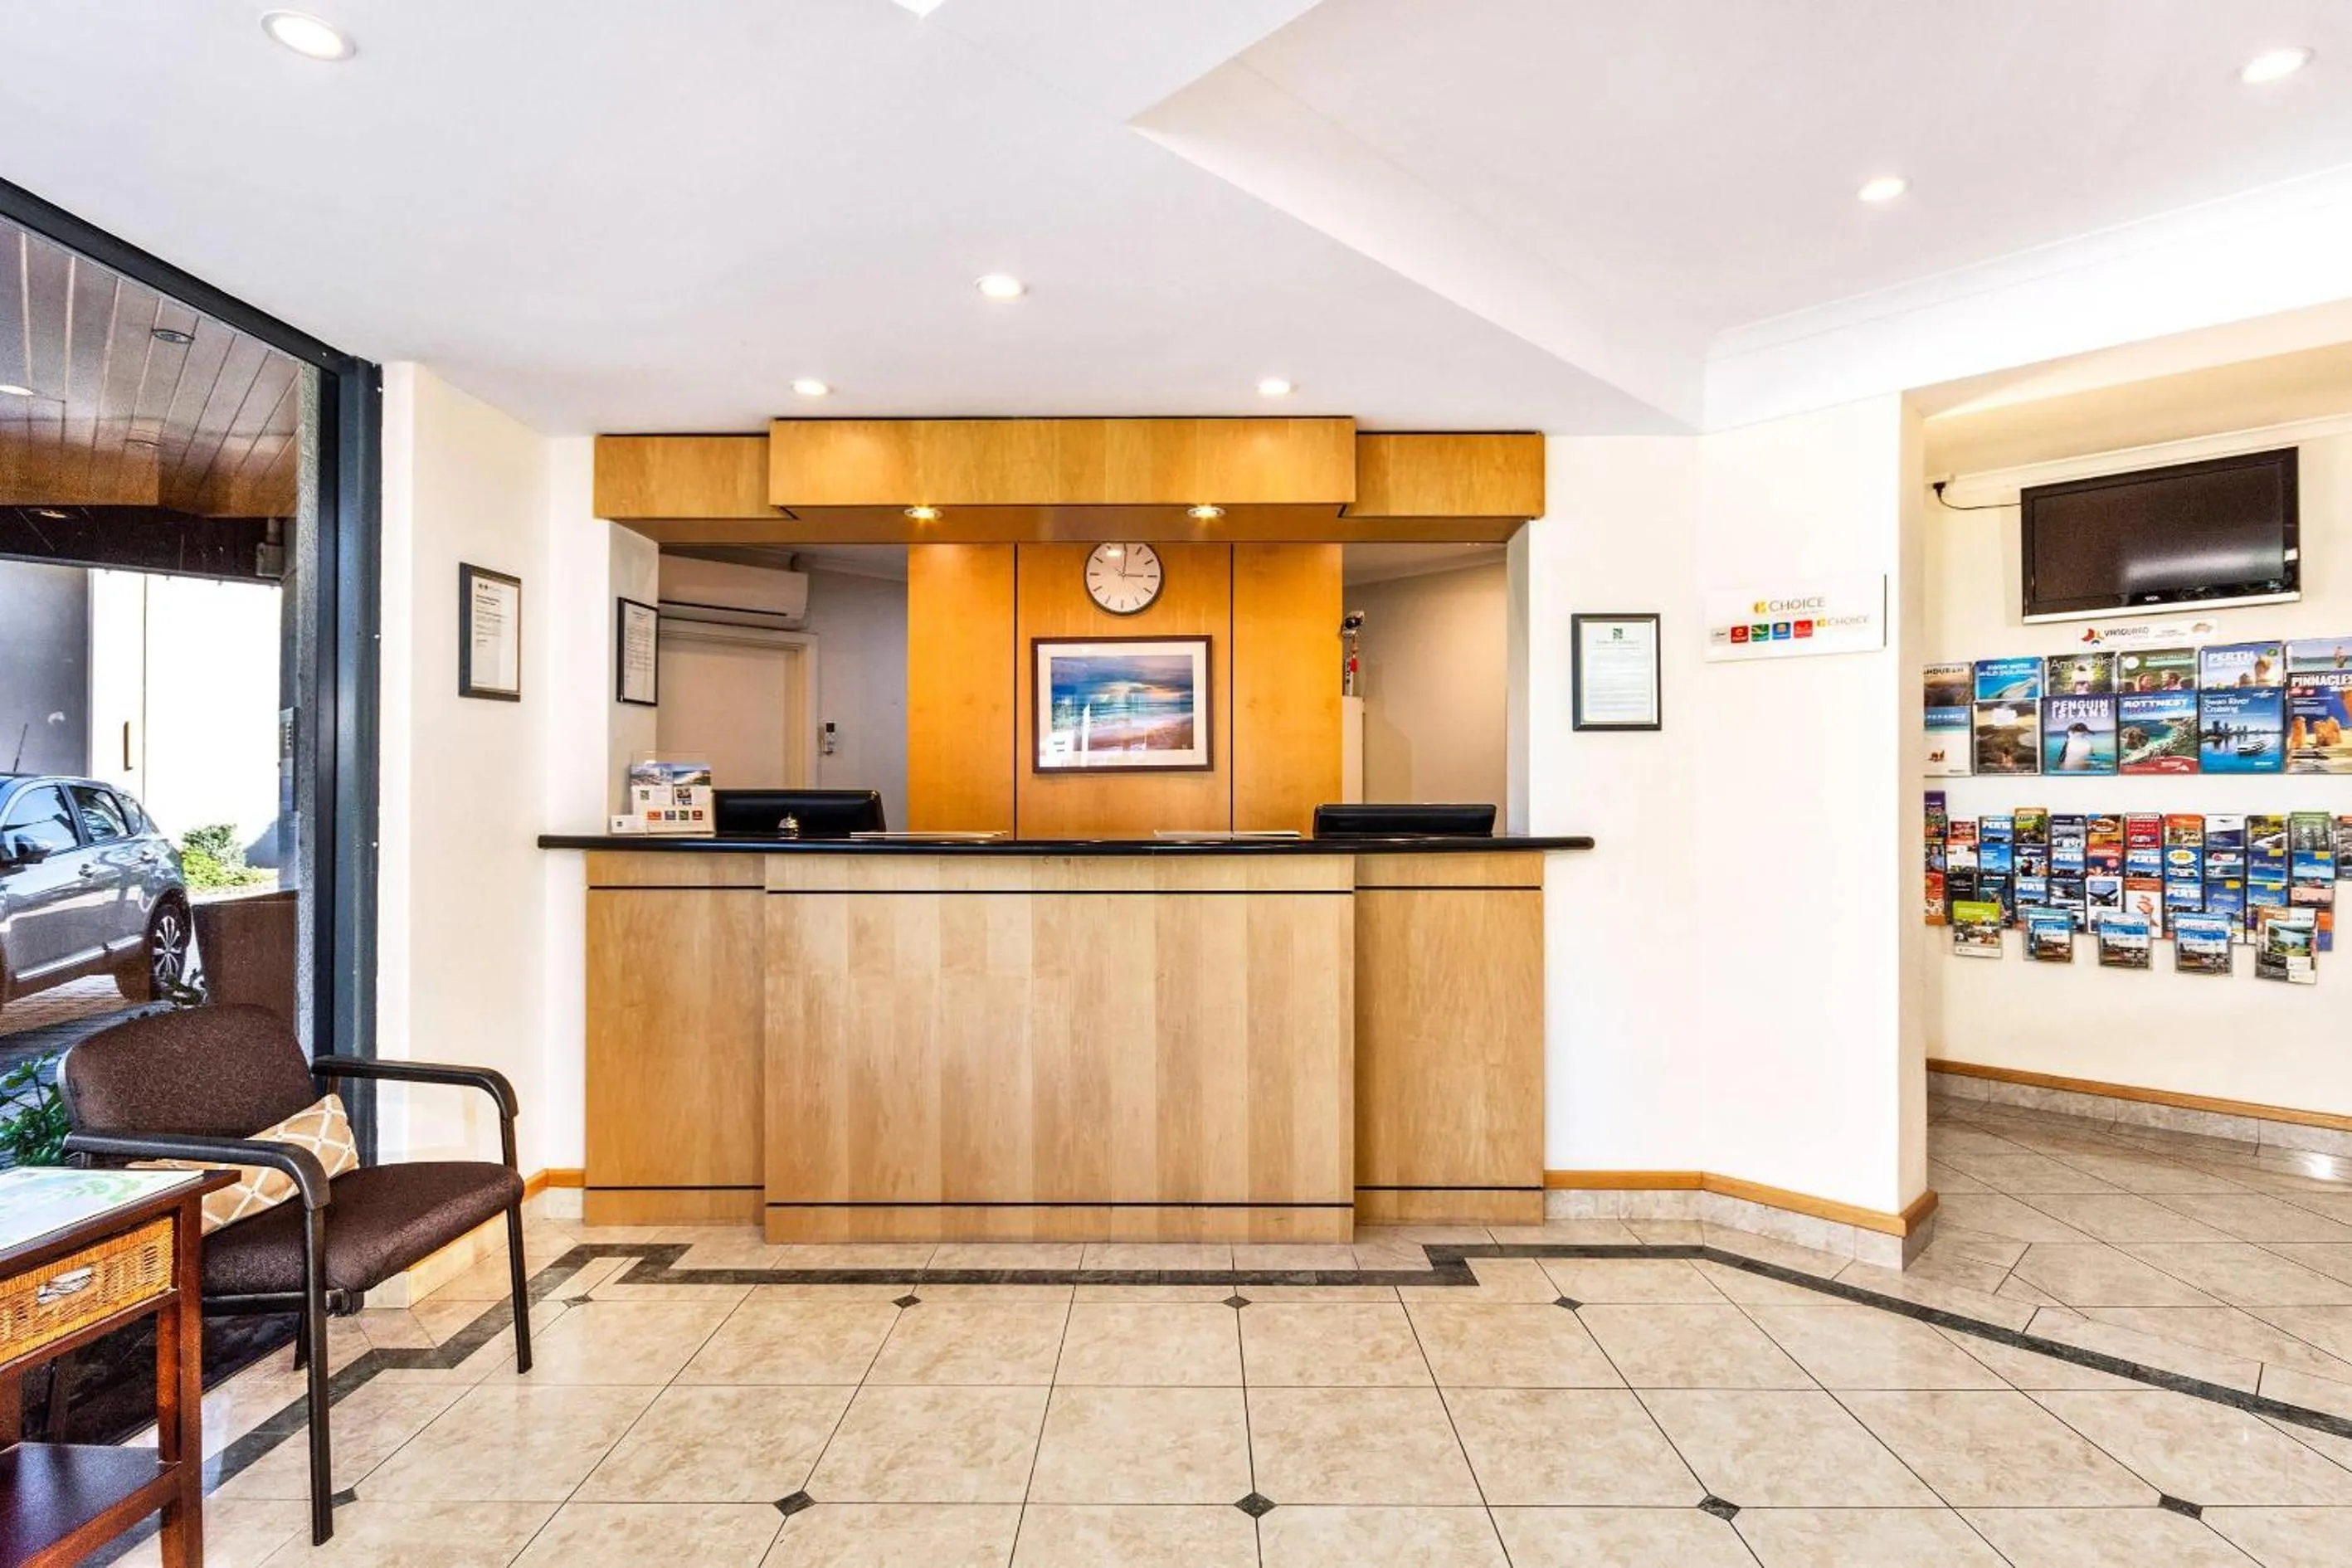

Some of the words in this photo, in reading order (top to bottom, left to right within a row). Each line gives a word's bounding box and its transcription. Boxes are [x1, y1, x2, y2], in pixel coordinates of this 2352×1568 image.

[1768, 597, 1825, 612] CHOICE
[1828, 615, 1869, 626] CHOICE
[2208, 650, 2254, 663] PERTH
[2052, 699, 2109, 710] PENGUIN
[2123, 699, 2188, 708] ROTTNEST
[2052, 709, 2110, 719] ISLAND
